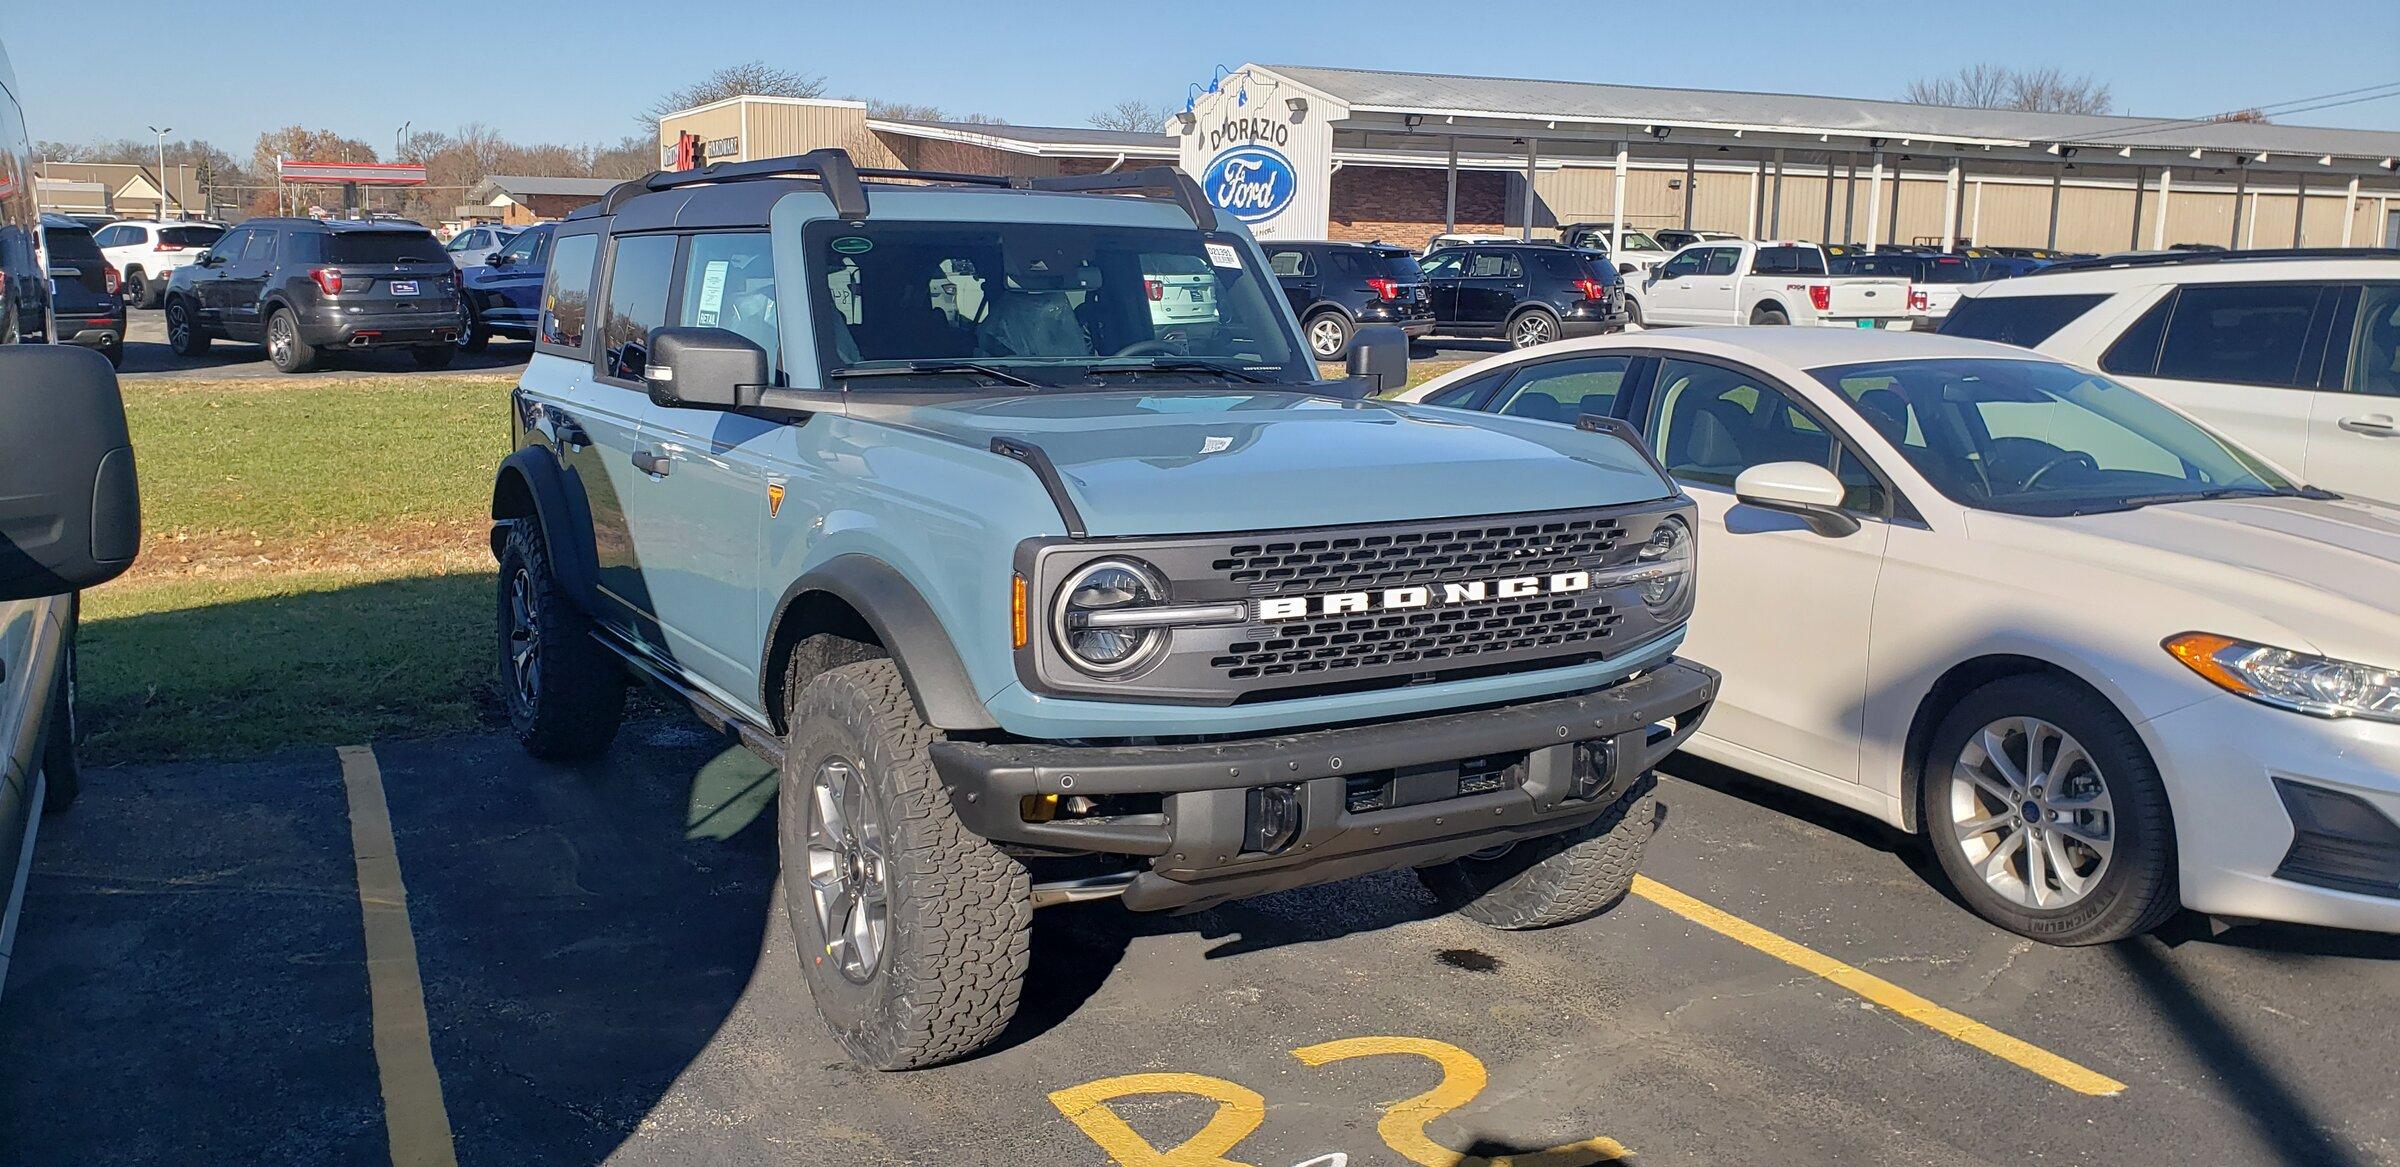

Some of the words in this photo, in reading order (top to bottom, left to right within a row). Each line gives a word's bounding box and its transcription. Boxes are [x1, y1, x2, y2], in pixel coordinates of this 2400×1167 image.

[1211, 118, 1288, 151] D'ORAZIO
[1218, 158, 1278, 209] Ford
[1260, 571, 1590, 621] BRONCO
[2033, 905, 2098, 933] MICHELIN
